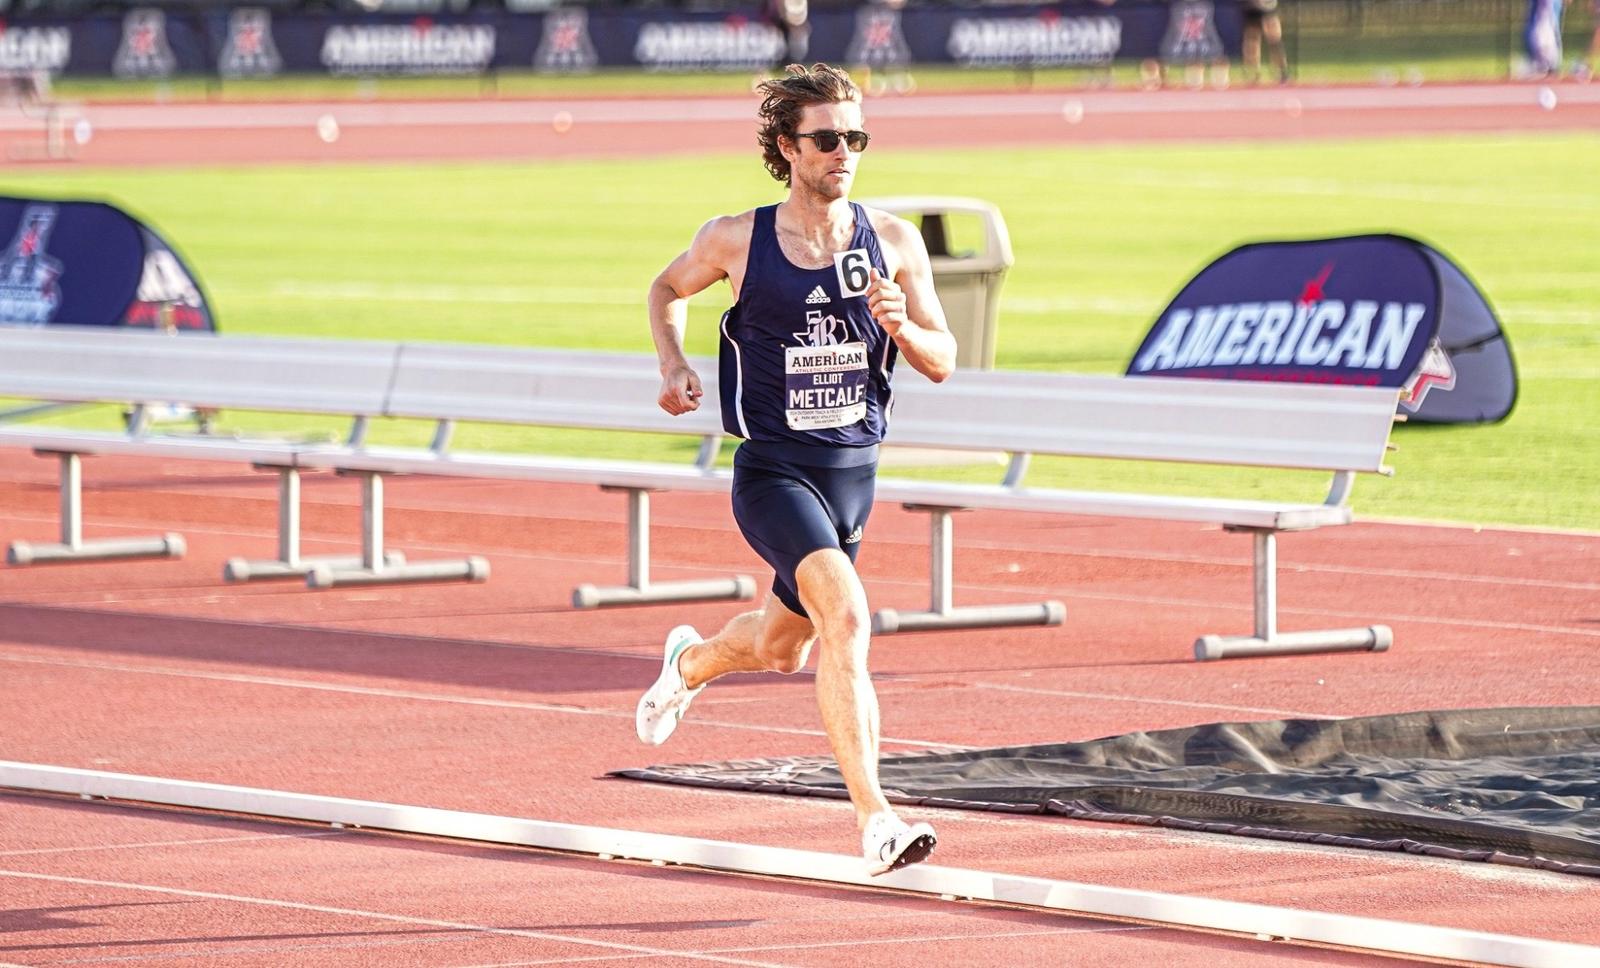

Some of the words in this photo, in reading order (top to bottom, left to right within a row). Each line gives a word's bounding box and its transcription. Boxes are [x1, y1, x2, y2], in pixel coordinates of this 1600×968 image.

[842, 253, 869, 292] 6
[805, 296, 831, 304] adidas
[1136, 299, 1427, 372] AMERICAN
[792, 352, 862, 368] AMERICAN
[813, 373, 843, 385] ELLIOT
[789, 384, 865, 409] METCALF
